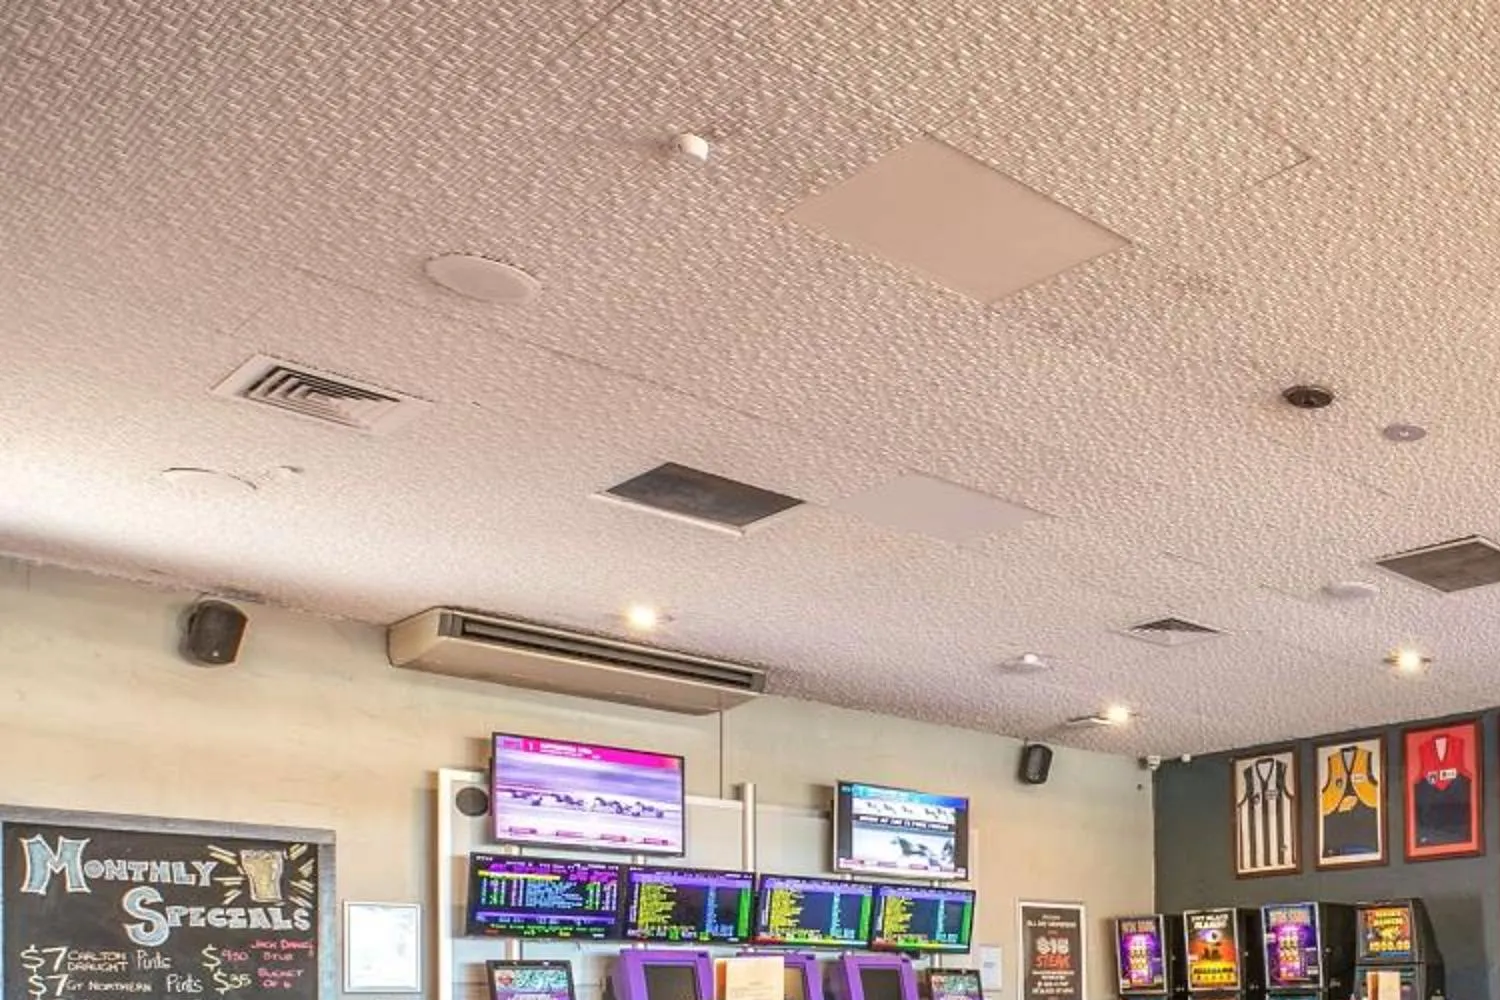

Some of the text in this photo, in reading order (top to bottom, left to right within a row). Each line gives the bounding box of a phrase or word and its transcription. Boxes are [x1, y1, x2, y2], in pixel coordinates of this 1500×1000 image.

[19, 833, 218, 894] MONTHLY
[121, 886, 311, 947] SPECIALS
[20, 944, 68, 973] $7
[68, 951, 127, 961] CARLTON
[28, 974, 68, 999] $7
